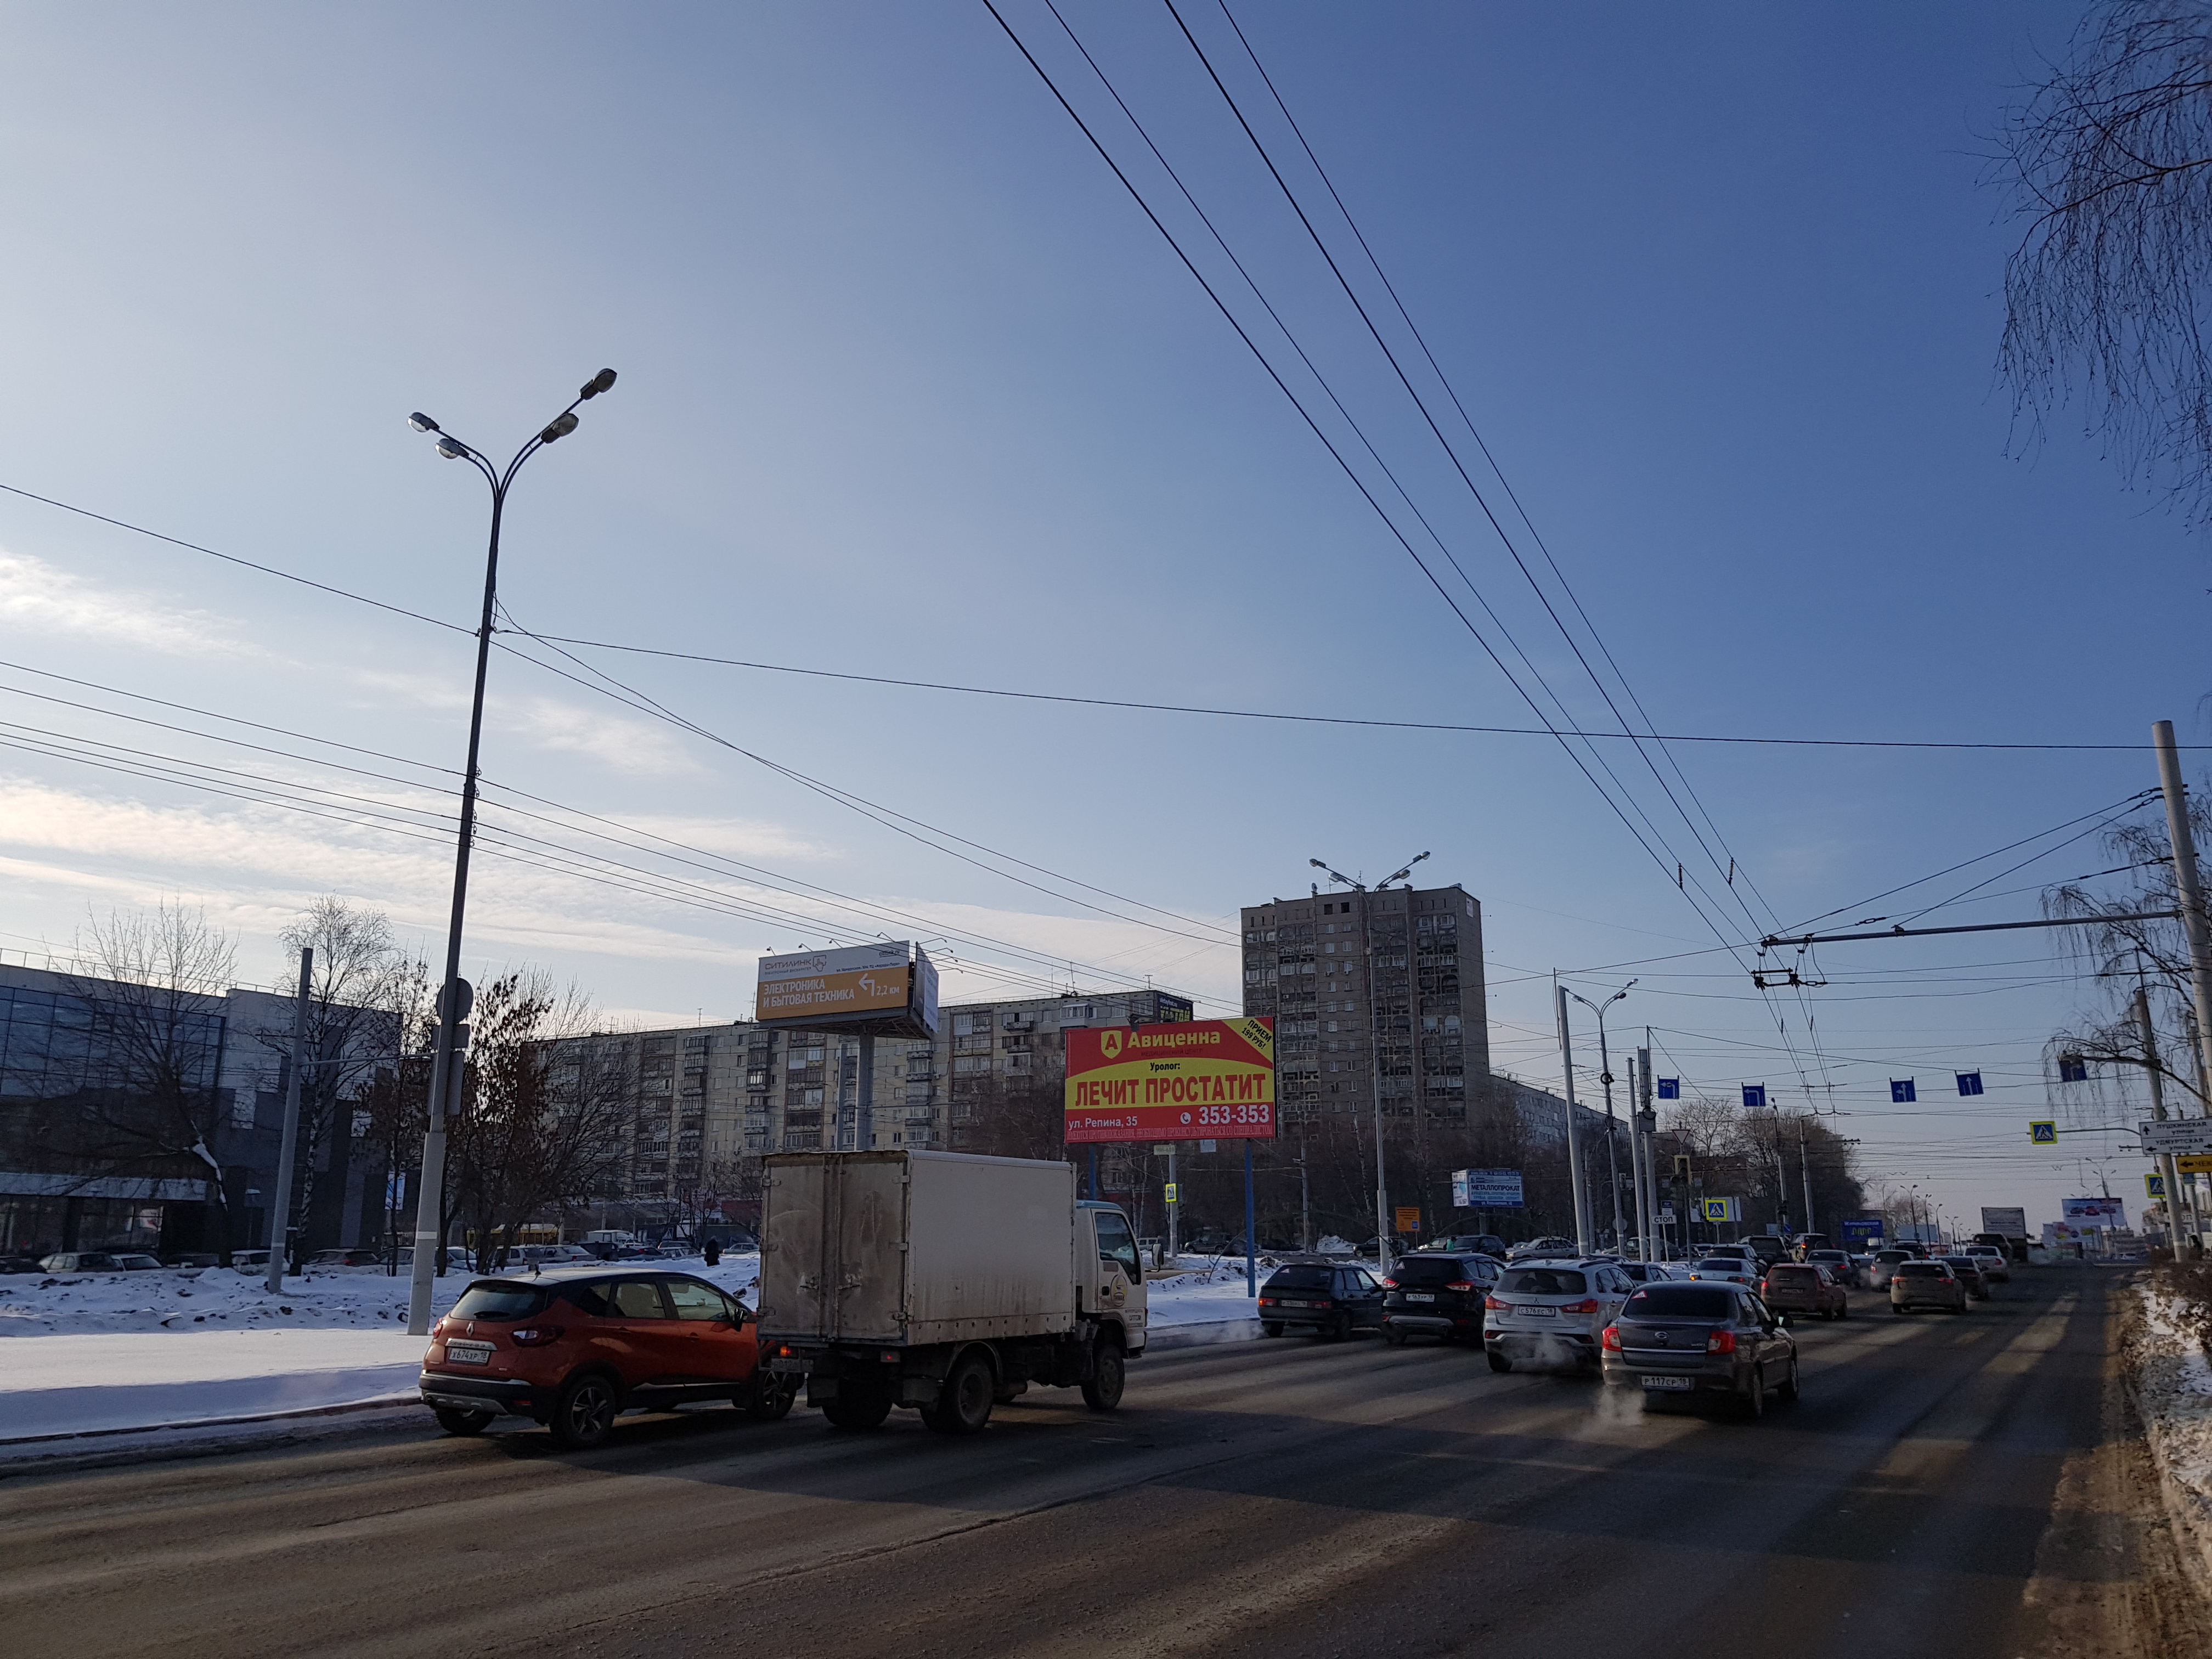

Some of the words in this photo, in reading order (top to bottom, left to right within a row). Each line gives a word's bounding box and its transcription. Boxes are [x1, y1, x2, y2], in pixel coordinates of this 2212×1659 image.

[765, 958, 812, 970] СИТИЛИНК
[764, 979, 825, 995] ЭЛЕКТРОНИКА
[876, 985, 888, 997] 2,2
[889, 986, 900, 994] км
[763, 997, 770, 1008] И
[771, 992, 812, 1007] БЫТОВАЯ
[815, 989, 855, 1002] ТЕХНИКА
[1242, 1028, 1254, 1039] 199
[1251, 1035, 1266, 1049] РУБ!
[1248, 1019, 1272, 1042] ПРИЕМ
[1127, 1031, 1220, 1048] Авиценна
[1150, 1062, 1181, 1073] Уролог:
[1075, 1079, 1139, 1107] ЛЕЧИТ
[1146, 1074, 1266, 1103] ПРОСТАТИТ
[1199, 1104, 1269, 1125] 353-353
[1069, 1120, 1083, 1131] ул.
[1085, 1118, 1124, 1128] Репина,
[1126, 1116, 1138, 1126] 35
[1645, 1377, 1676, 1386] Р117СР
